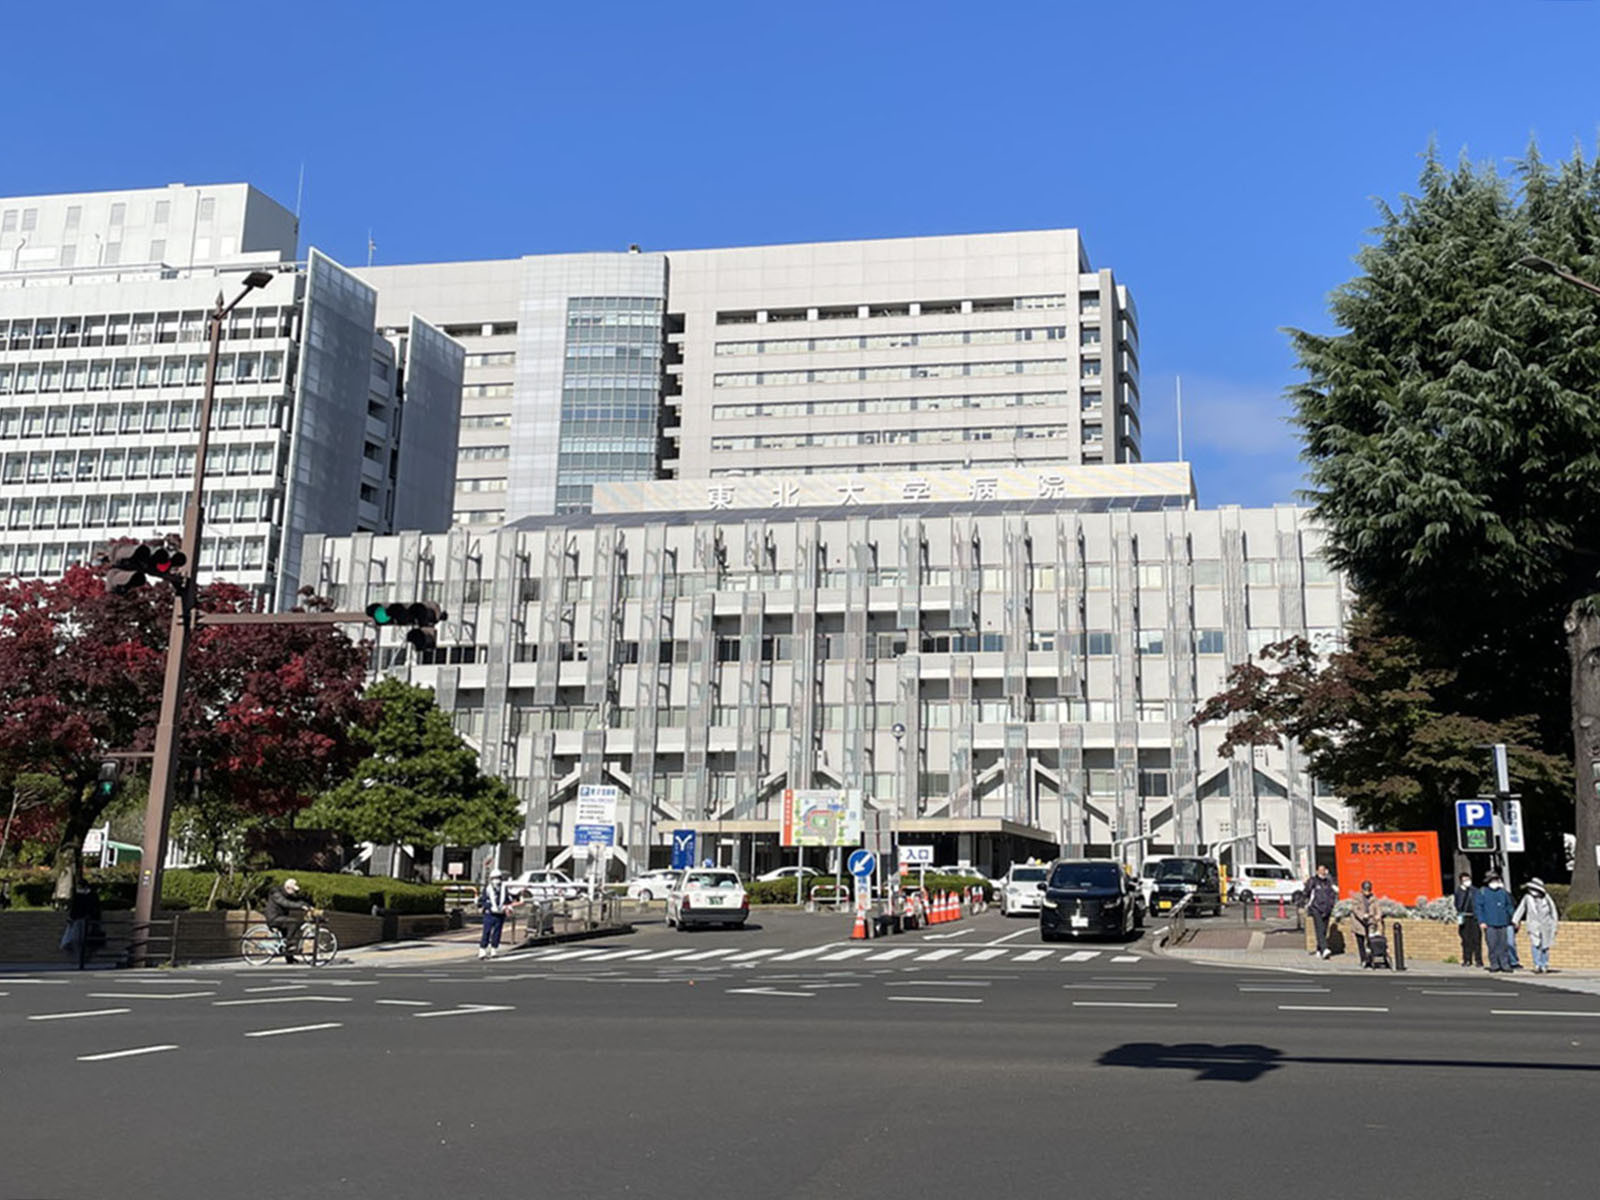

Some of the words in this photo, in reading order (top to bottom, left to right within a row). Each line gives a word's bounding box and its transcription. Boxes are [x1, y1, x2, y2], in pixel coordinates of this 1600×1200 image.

[707, 475, 1066, 511] 東北大学病院
[1465, 804, 1484, 825] P
[905, 848, 929, 860] 入口
